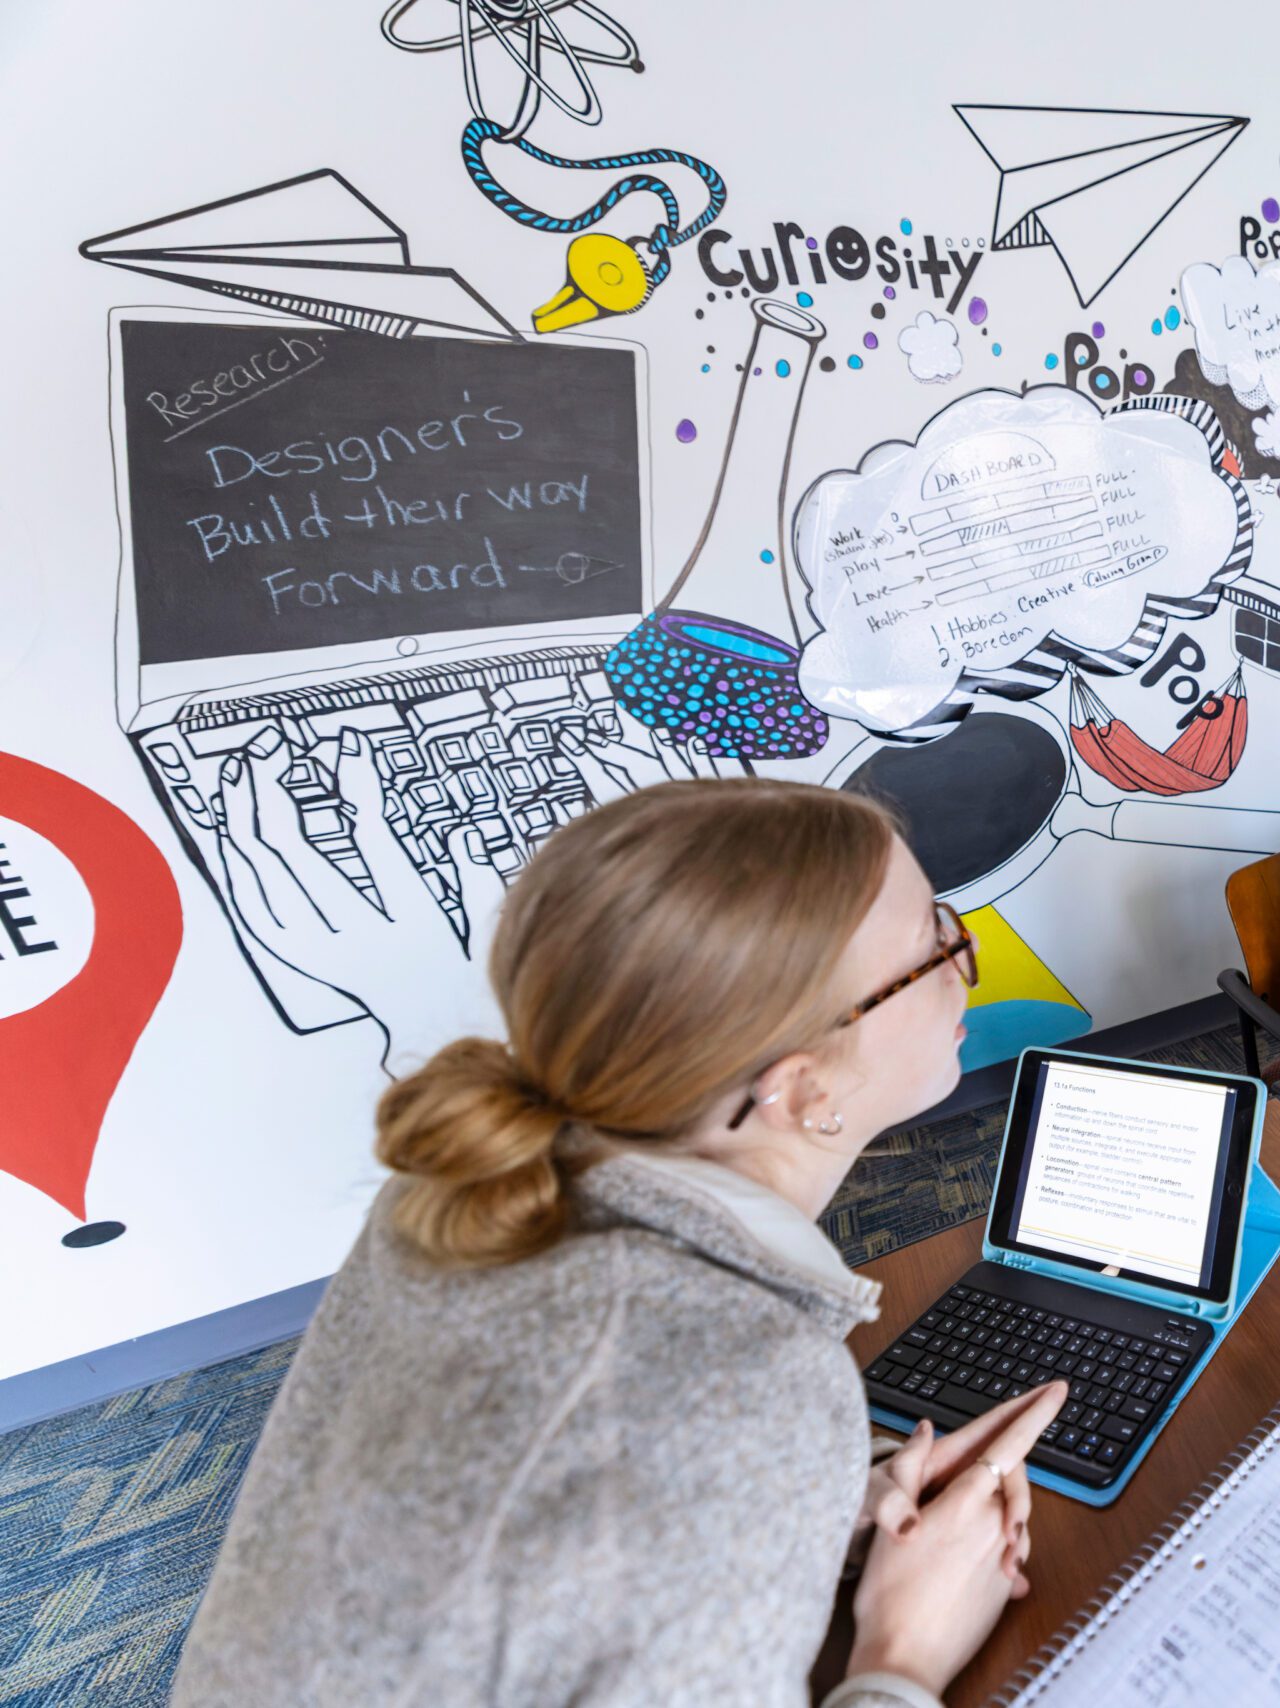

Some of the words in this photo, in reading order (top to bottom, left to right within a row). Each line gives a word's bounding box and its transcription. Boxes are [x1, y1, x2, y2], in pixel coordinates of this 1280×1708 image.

[698, 221, 983, 315] Curiosity
[1065, 332, 1155, 402] Pop
[206, 390, 525, 487] Designer's
[187, 492, 332, 562] Build
[344, 486, 470, 528] their
[487, 475, 589, 512] way
[262, 536, 507, 614] Forward
[1140, 632, 1224, 730] Pop
